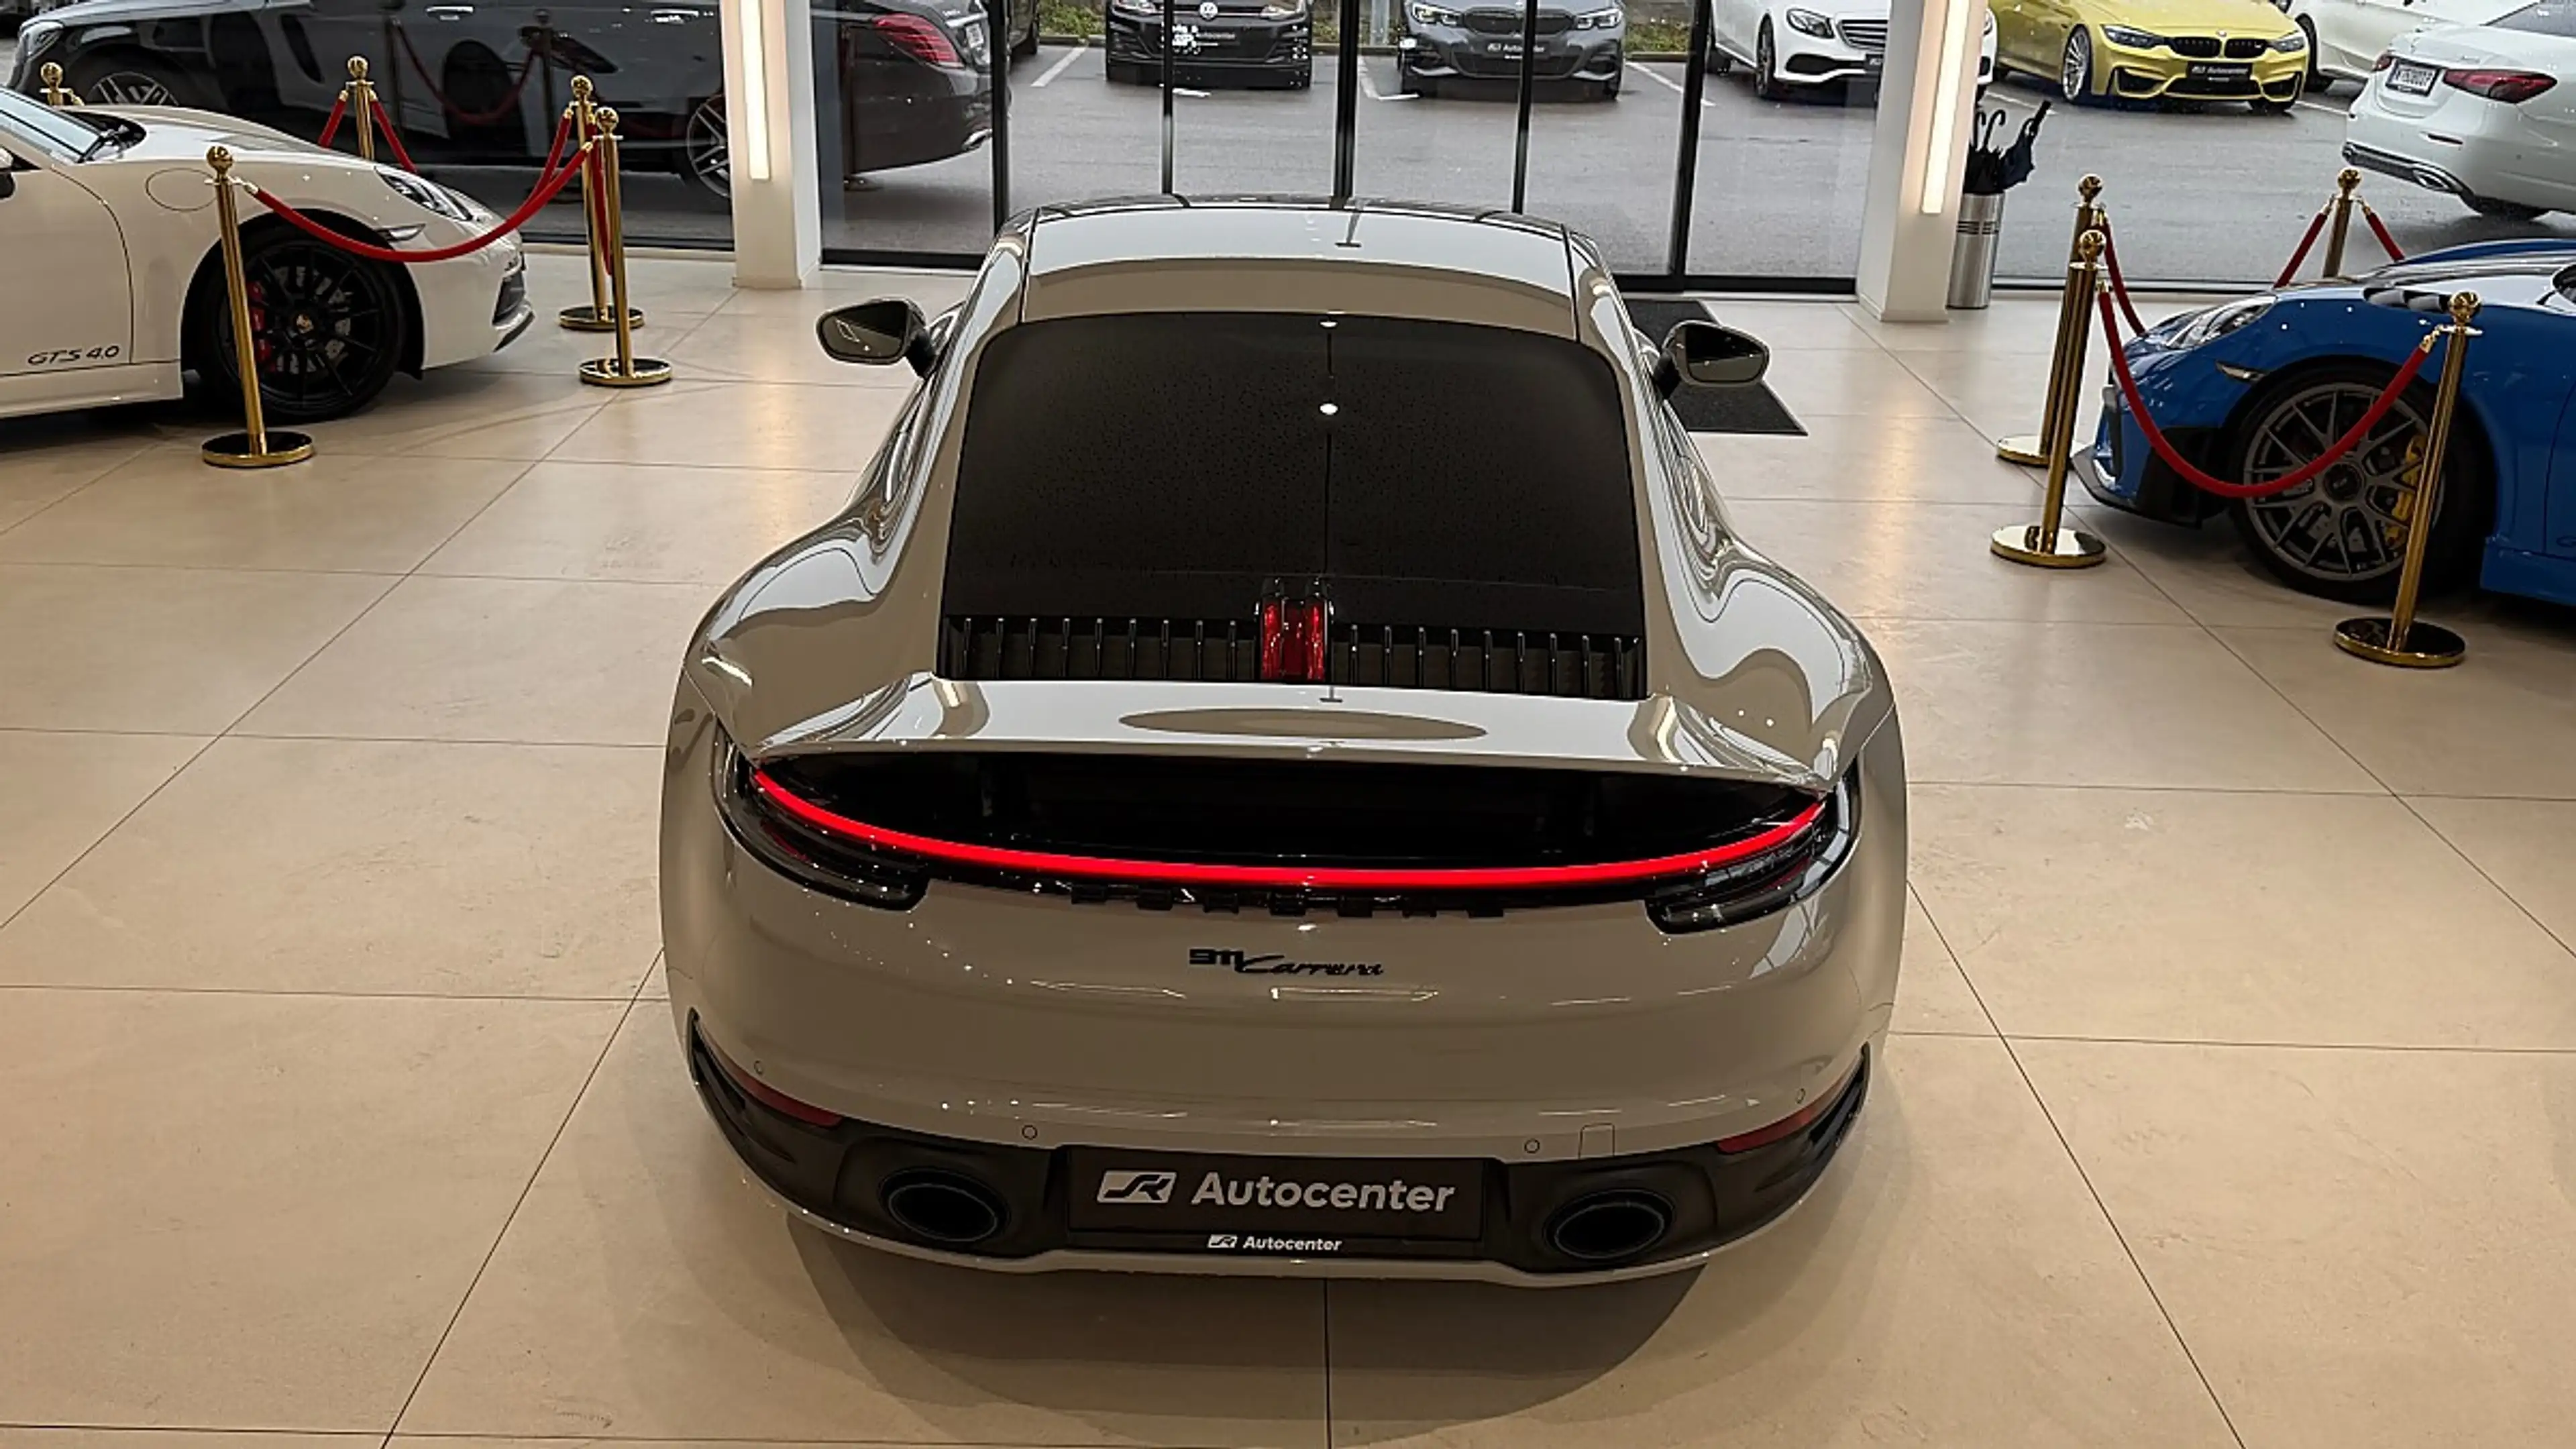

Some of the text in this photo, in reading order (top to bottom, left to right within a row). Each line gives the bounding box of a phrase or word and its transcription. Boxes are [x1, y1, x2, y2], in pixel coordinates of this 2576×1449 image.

[28, 345, 119, 365] GTS 4.0
[1189, 949, 1384, 975] 911 Carrera
[1191, 1172, 1456, 1212] Autocenter
[1242, 1236, 1342, 1251] Autocenter
